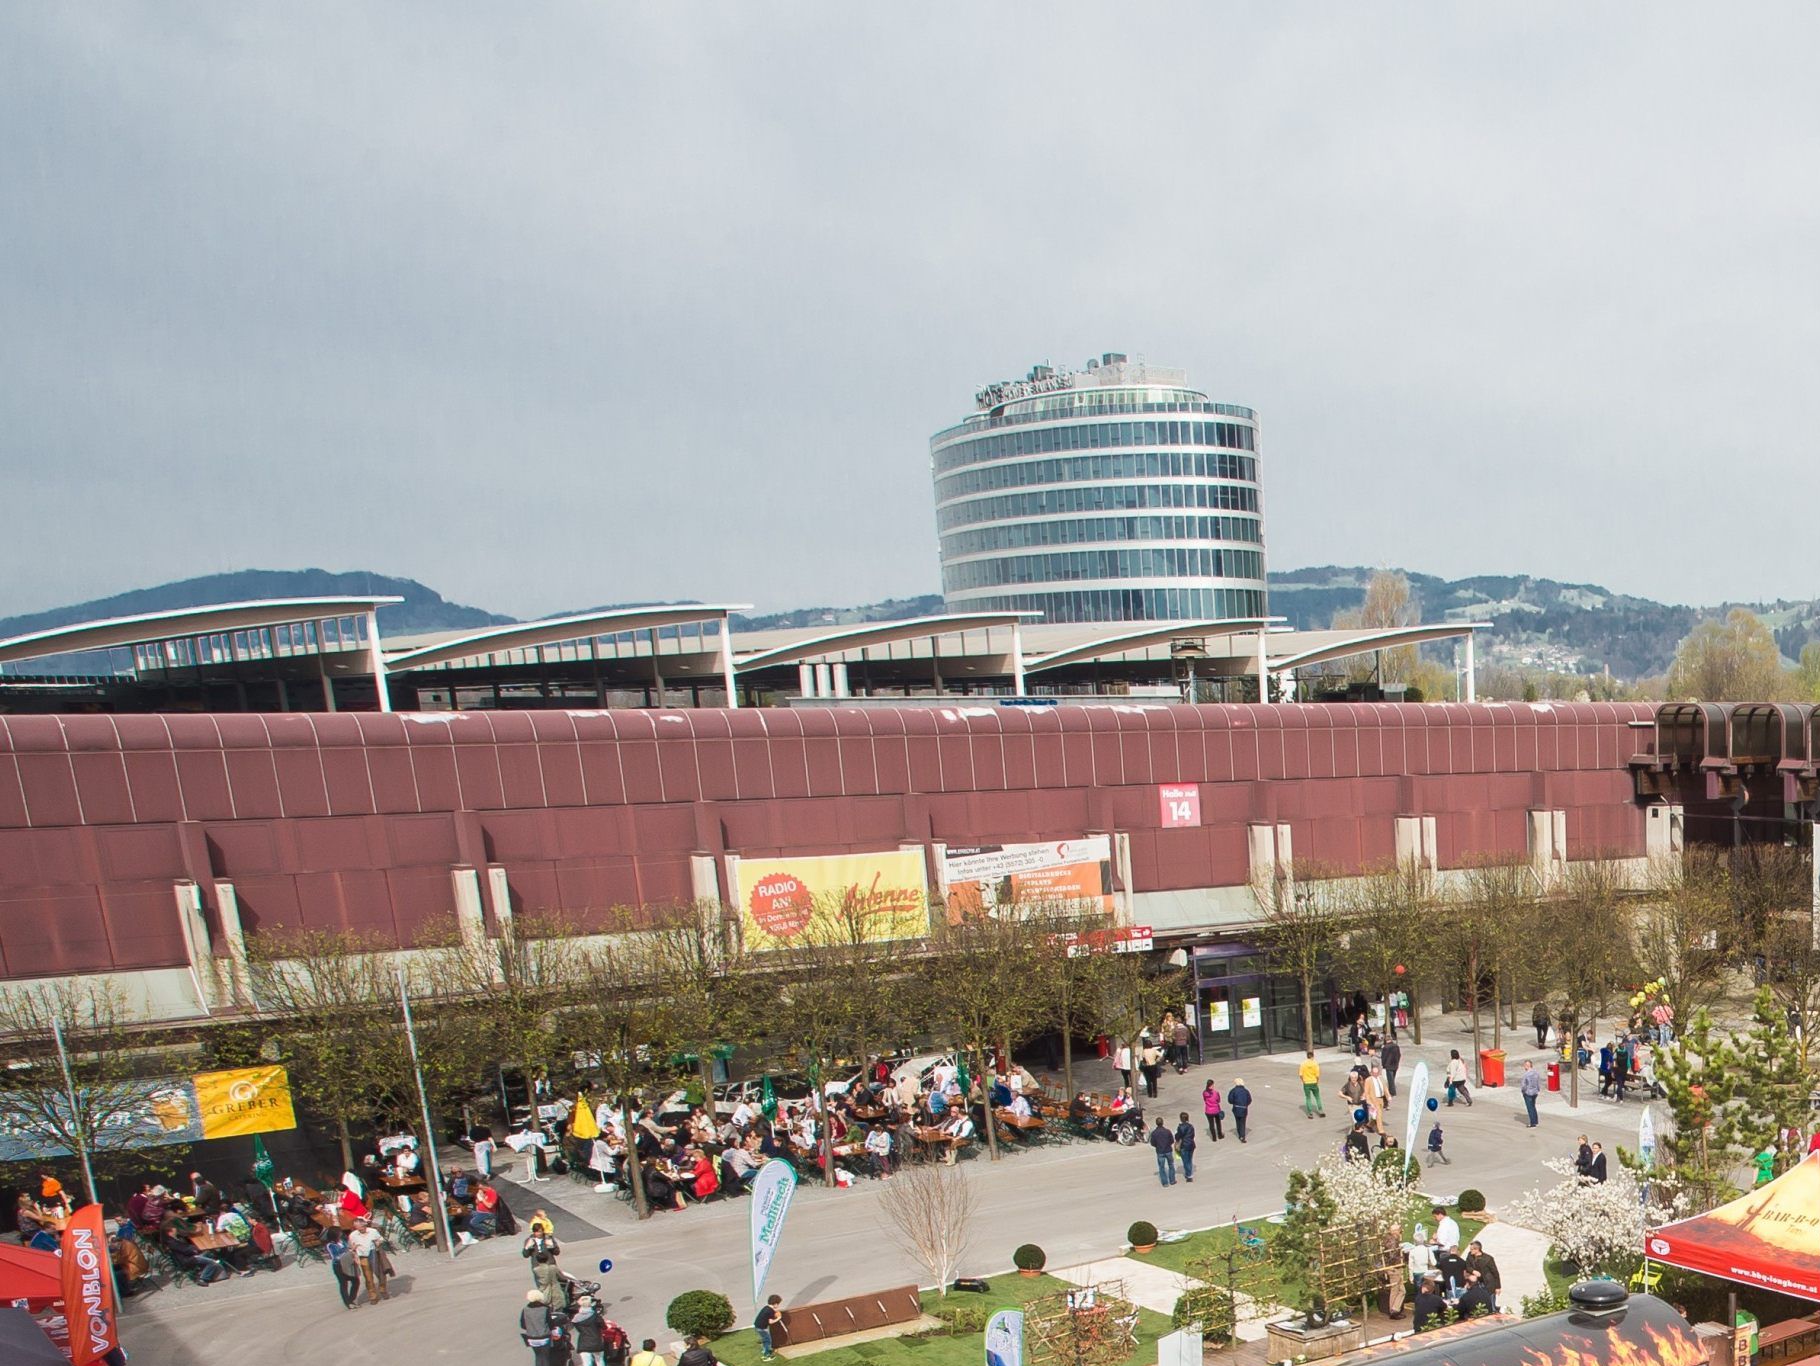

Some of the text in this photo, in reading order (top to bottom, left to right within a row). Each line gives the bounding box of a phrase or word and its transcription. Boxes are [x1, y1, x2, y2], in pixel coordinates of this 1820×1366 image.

[1169, 801, 1191, 820] 14
[964, 858, 985, 867] könnte
[986, 856, 998, 864] Ihre
[1000, 851, 1028, 862] Werbung
[1029, 848, 1050, 858] stehen
[974, 866, 992, 874] unter
[758, 880, 797, 897] RADIO
[772, 896, 792, 910] AN!
[211, 1097, 281, 1116] GREBER
[1730, 1266, 1818, 1294] www.bbq-longhorn.at
[72, 1228, 110, 1354] VONBLON
